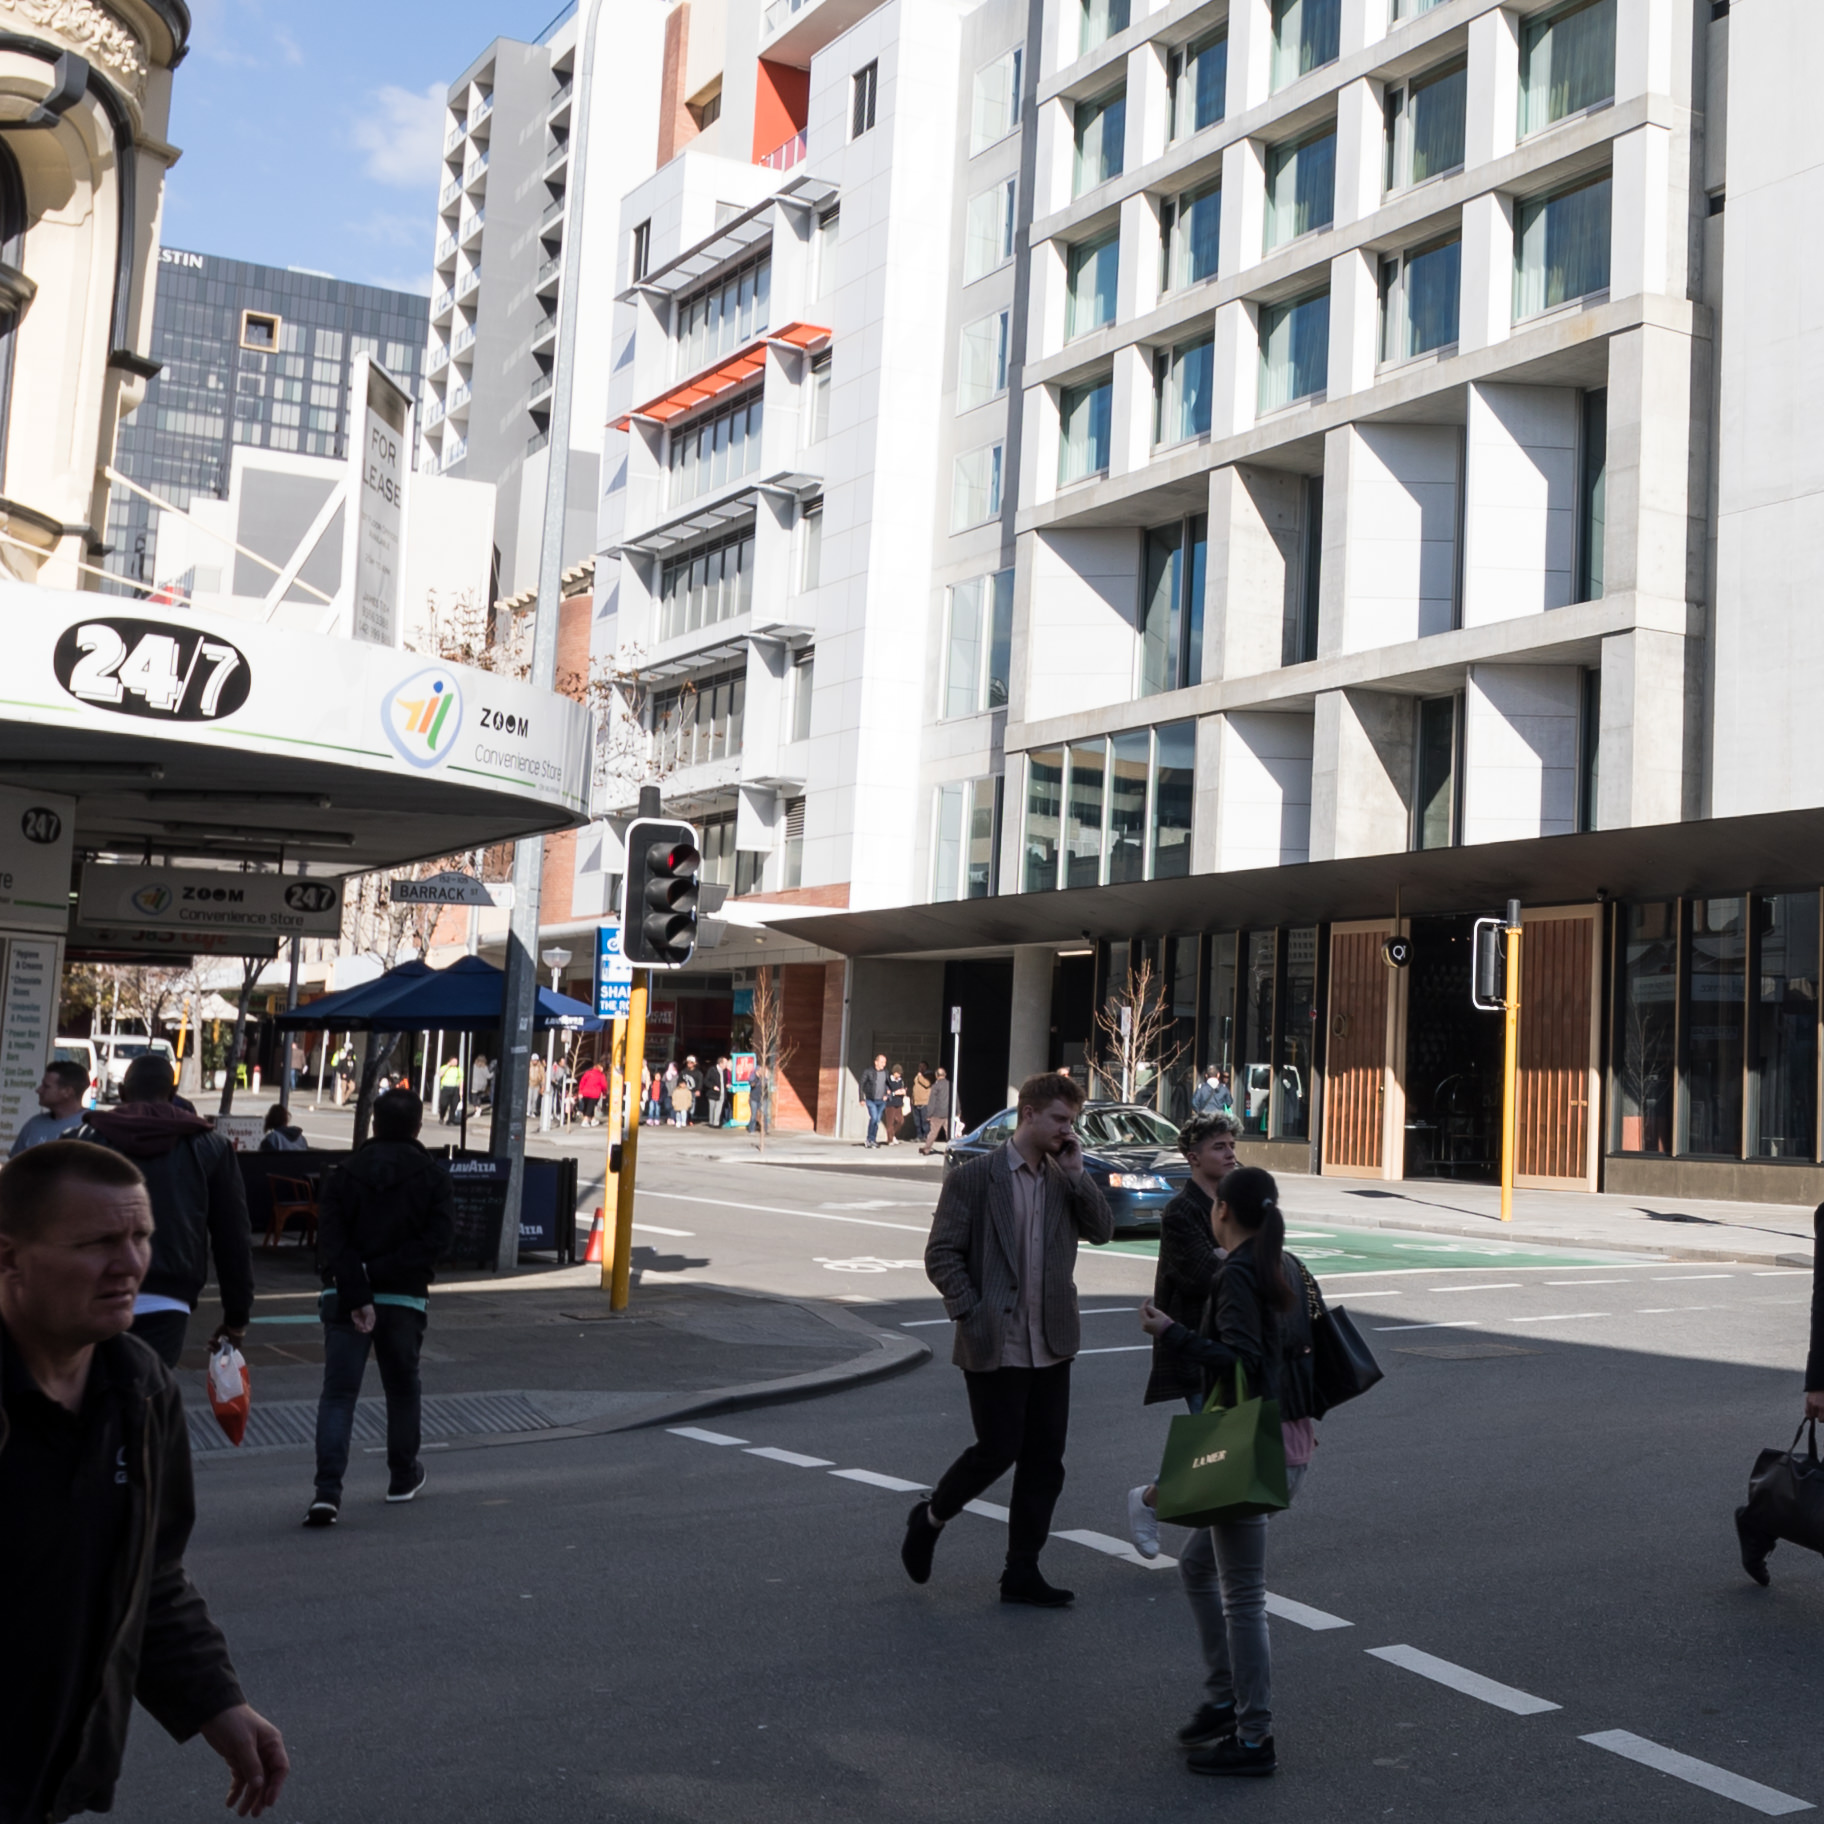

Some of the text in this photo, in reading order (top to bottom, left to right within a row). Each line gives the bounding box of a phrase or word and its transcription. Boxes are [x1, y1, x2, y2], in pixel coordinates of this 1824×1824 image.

[371, 426, 397, 469] FOR
[362, 464, 401, 511] LEASE
[69, 623, 240, 717] 24/7
[480, 707, 529, 739] ZOOM
[474, 743, 563, 782] Convenience Store
[26, 811, 58, 841] 247
[182, 886, 244, 903] ZOOM
[400, 884, 478, 901] BARRACK ST
[179, 907, 304, 927] Convenience Store
[600, 985, 632, 999] SHA
[600, 1000, 630, 1011] THE RO
[646, 1017, 673, 1025] ENTRE
[227, 1127, 253, 1137] Waste
[449, 1159, 497, 1173] LAVAZZA
[519, 1222, 544, 1236] AZZA
